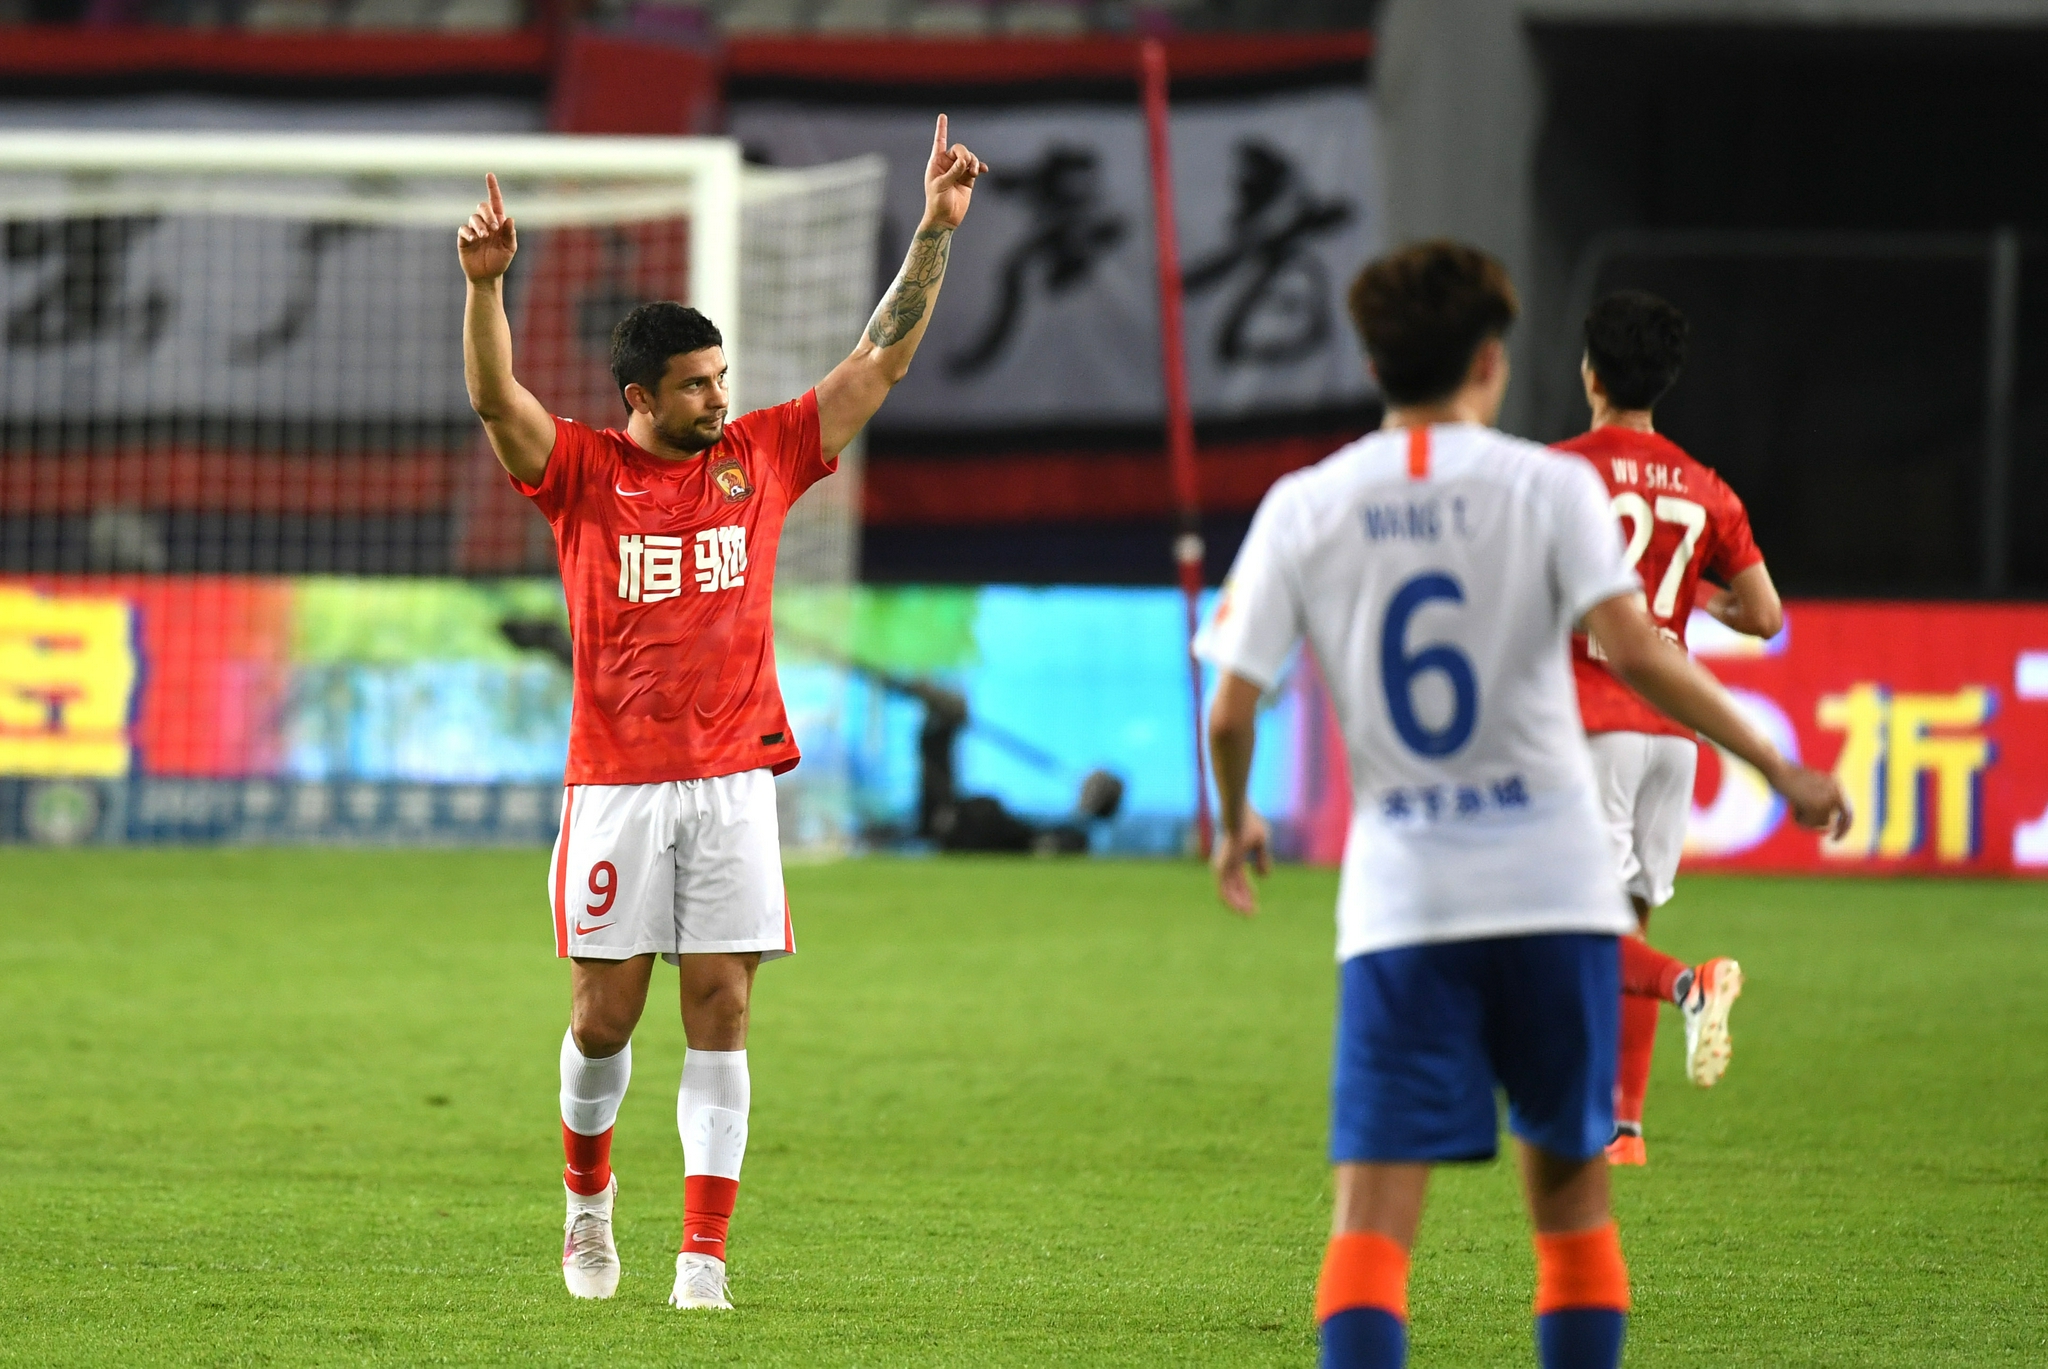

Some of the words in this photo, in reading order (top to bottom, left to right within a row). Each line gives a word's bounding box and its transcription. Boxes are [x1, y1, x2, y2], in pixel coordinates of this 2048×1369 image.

[1611, 458, 1638, 485] WU
[618, 525, 748, 603] 恒驰
[1608, 492, 1706, 618] 27
[1381, 571, 1478, 760] 6
[586, 860, 618, 917] 9
